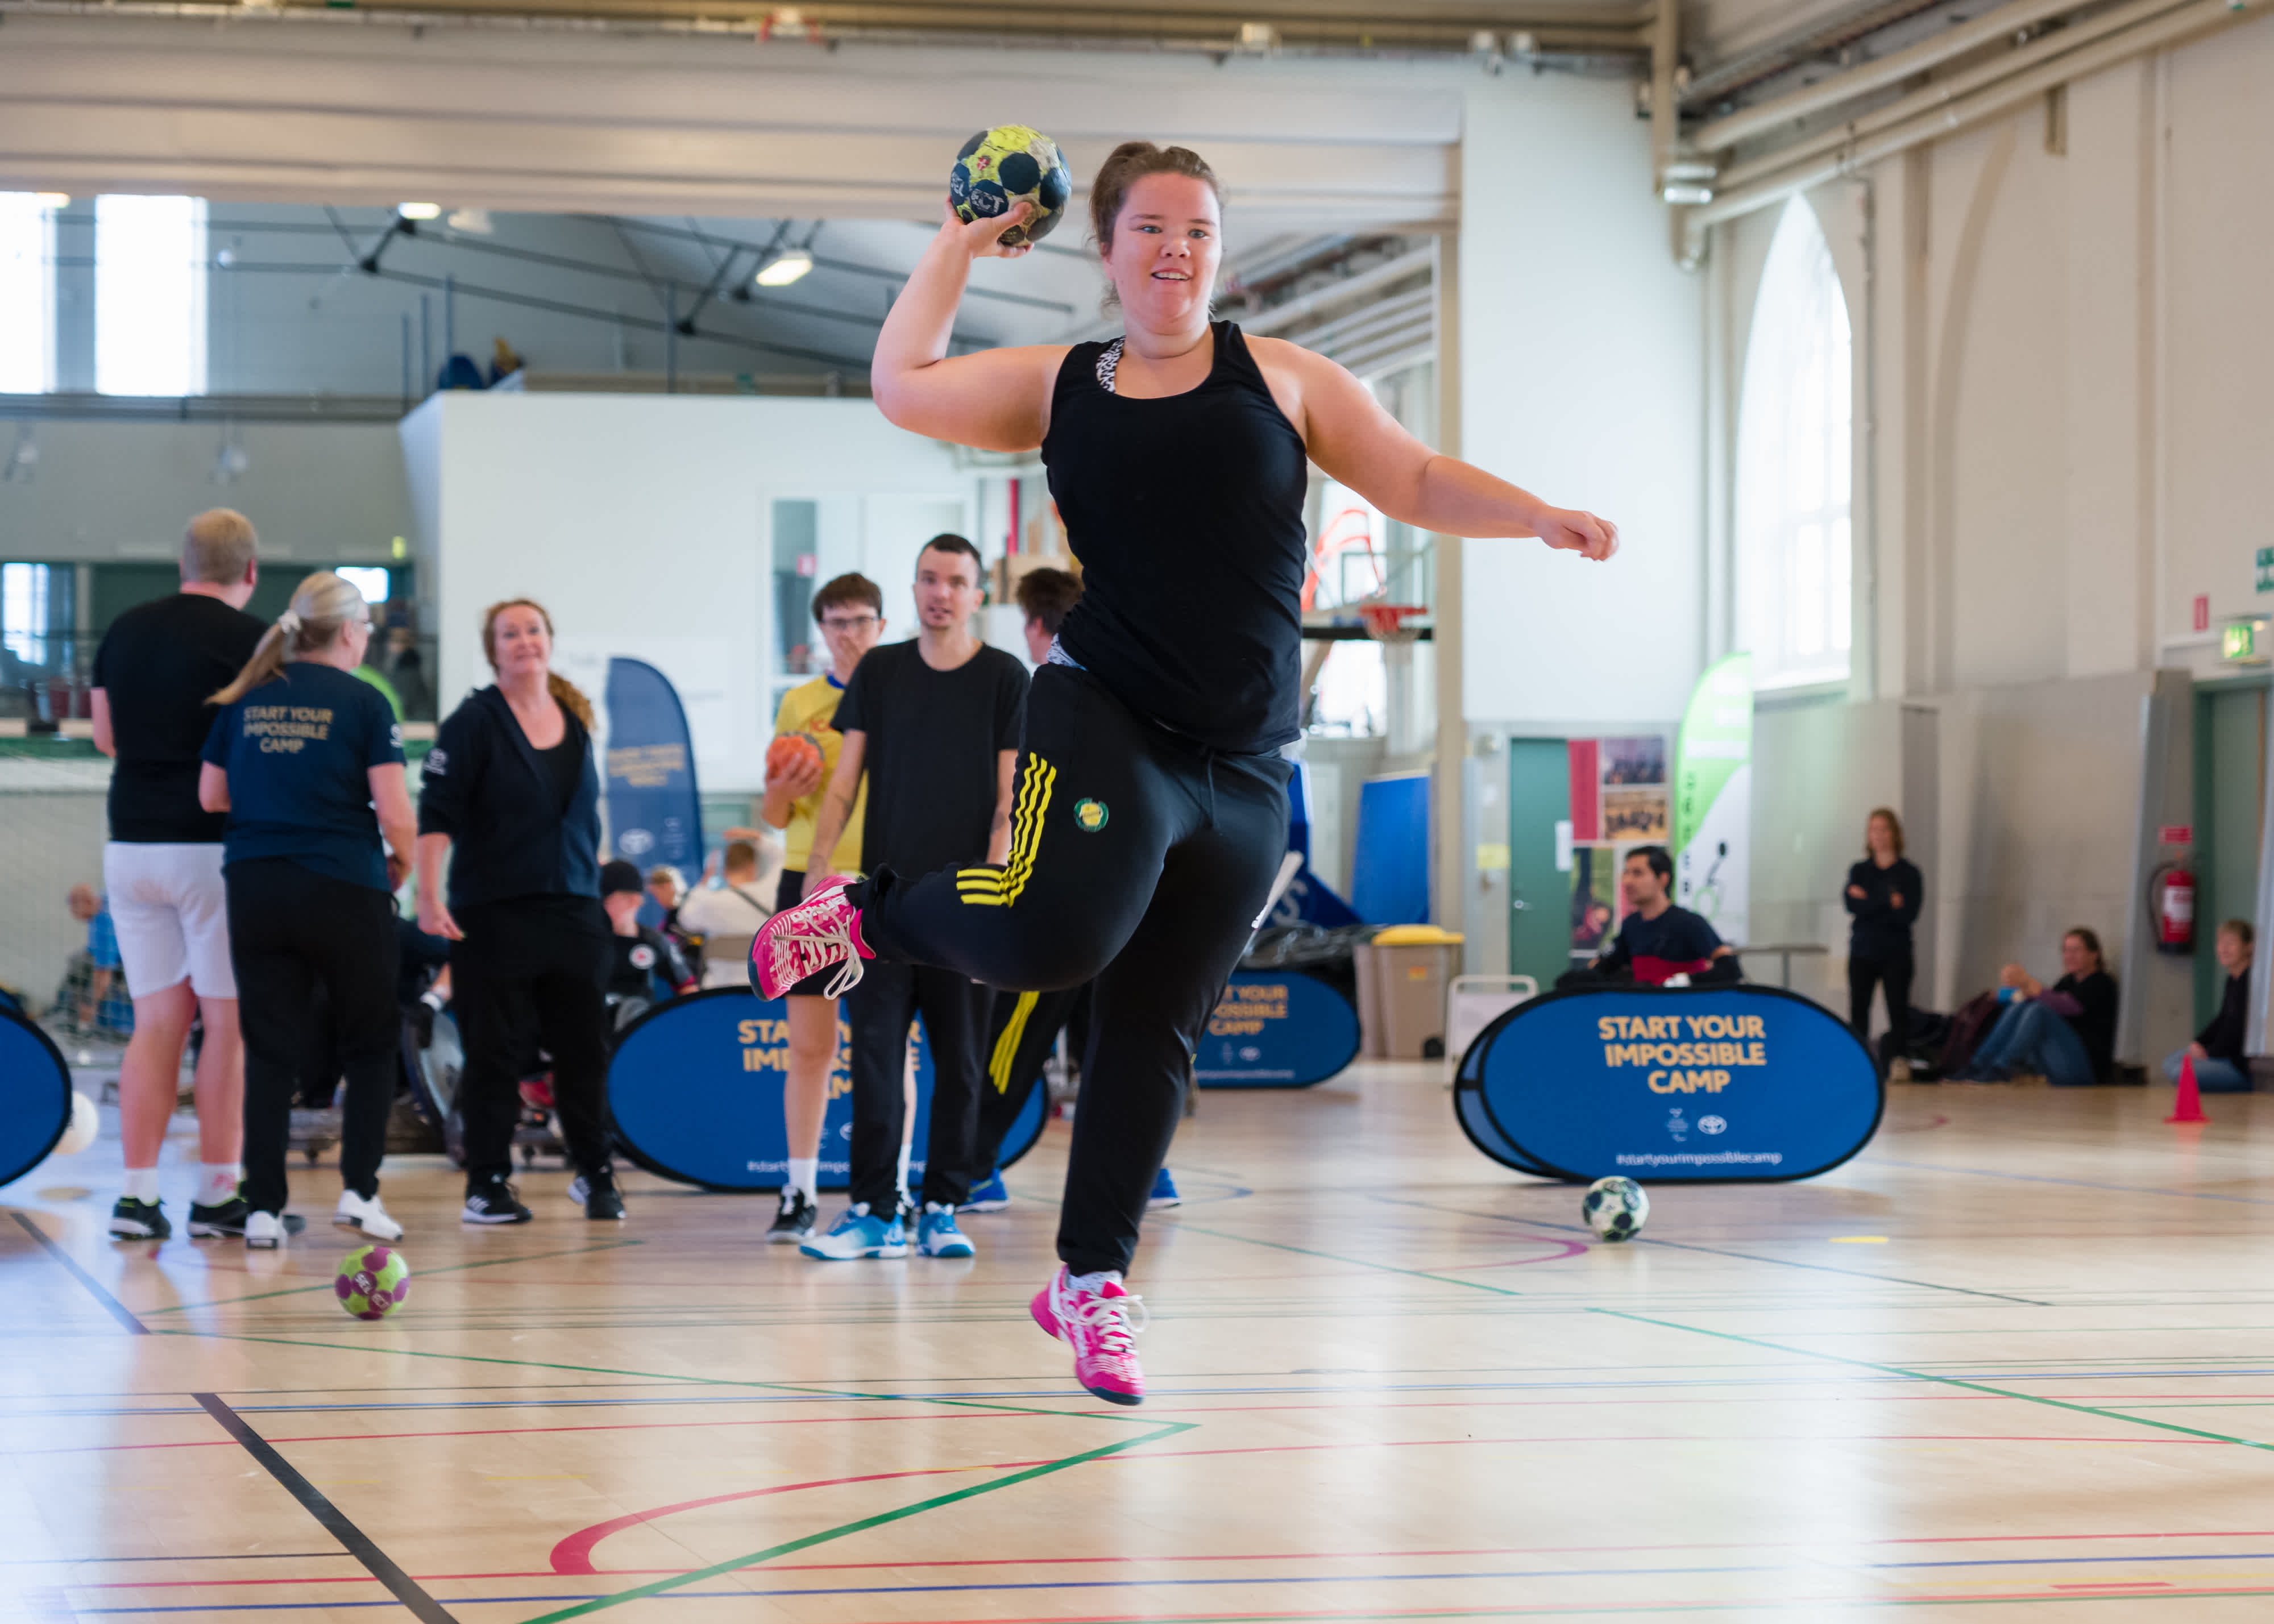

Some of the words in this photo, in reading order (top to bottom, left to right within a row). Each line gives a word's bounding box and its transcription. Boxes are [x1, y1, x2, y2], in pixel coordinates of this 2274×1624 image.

[243, 705, 288, 722] START
[291, 707, 333, 724] YOUR
[243, 721, 329, 740] IMPOSSIBLE
[260, 737, 305, 753] CAMP
[737, 1019, 791, 1044] STA
[1597, 1015, 1682, 1040] START
[1685, 1015, 1766, 1039] YOUR
[1604, 1042, 1767, 1067] IMPOSSIBLE
[1647, 1069, 1731, 1094] CAMP
